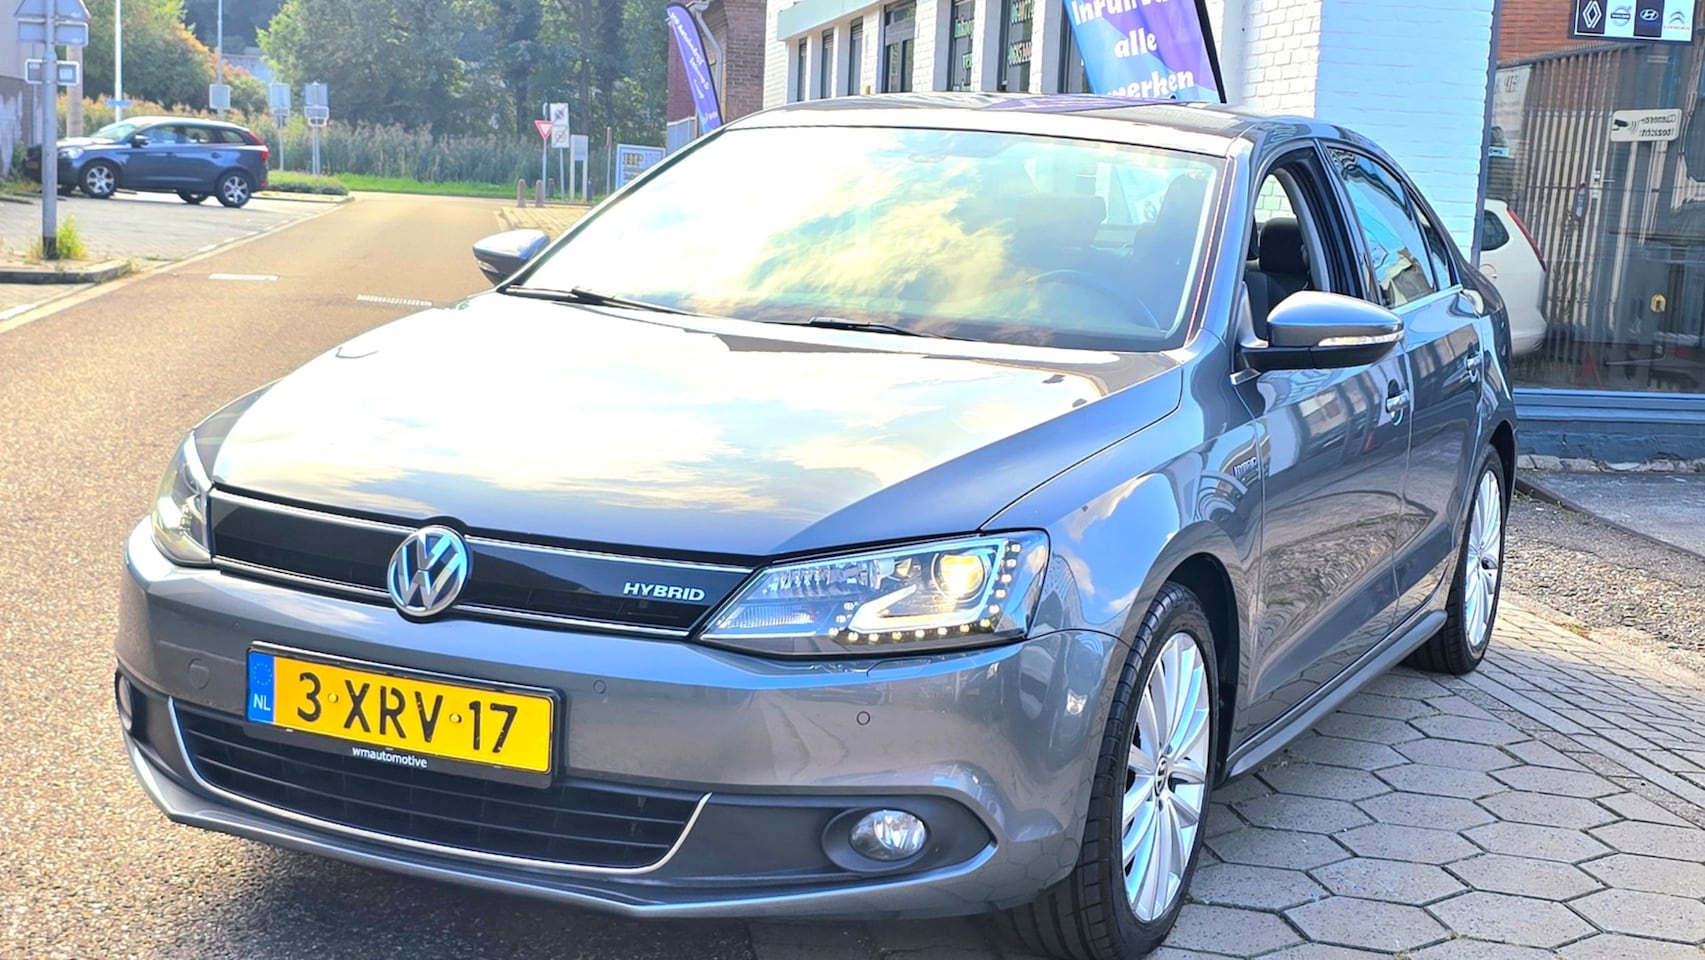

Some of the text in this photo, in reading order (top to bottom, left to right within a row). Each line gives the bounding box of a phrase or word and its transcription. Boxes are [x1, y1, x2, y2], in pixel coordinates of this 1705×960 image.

[1114, 28, 1157, 58] alle
[623, 582, 705, 601] HYBRID
[253, 692, 271, 712] NL
[351, 746, 428, 769] wmautomotive
